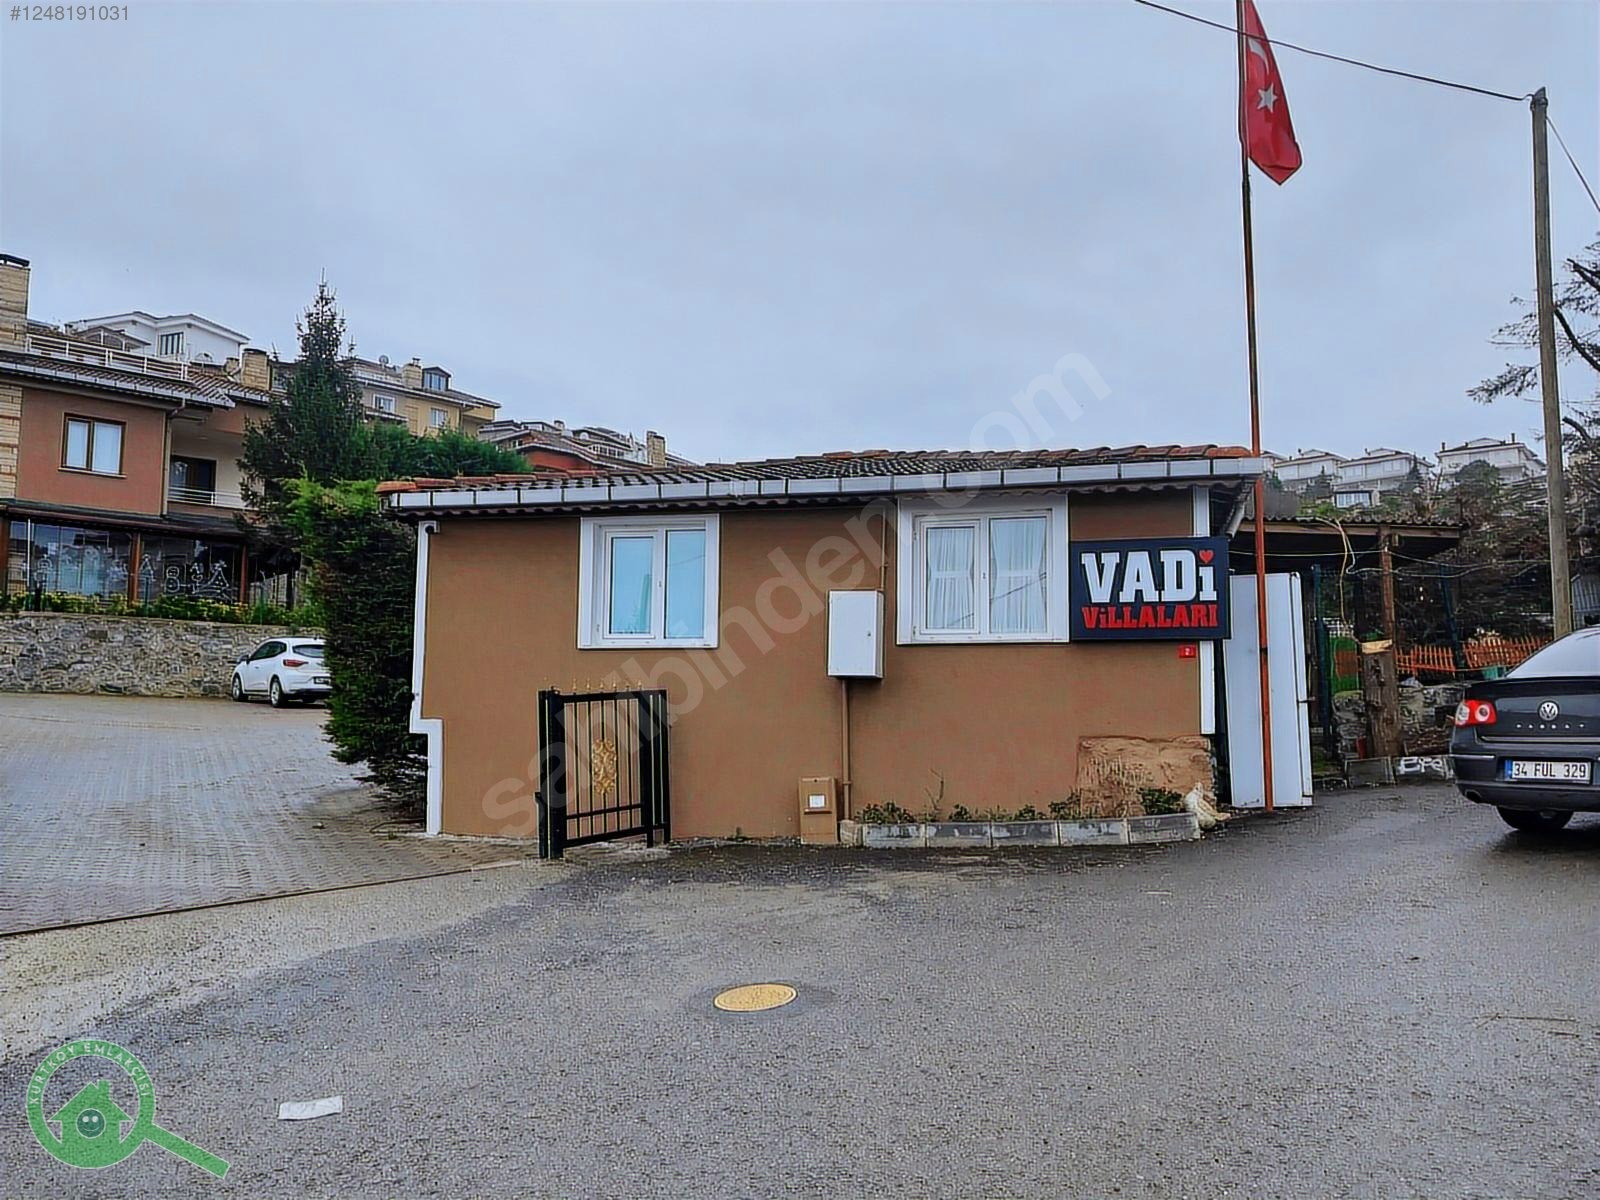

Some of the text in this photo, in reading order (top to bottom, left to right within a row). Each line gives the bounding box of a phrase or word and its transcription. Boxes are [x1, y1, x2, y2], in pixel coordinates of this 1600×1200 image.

[1514, 763, 1587, 778] 34 FUL 329
